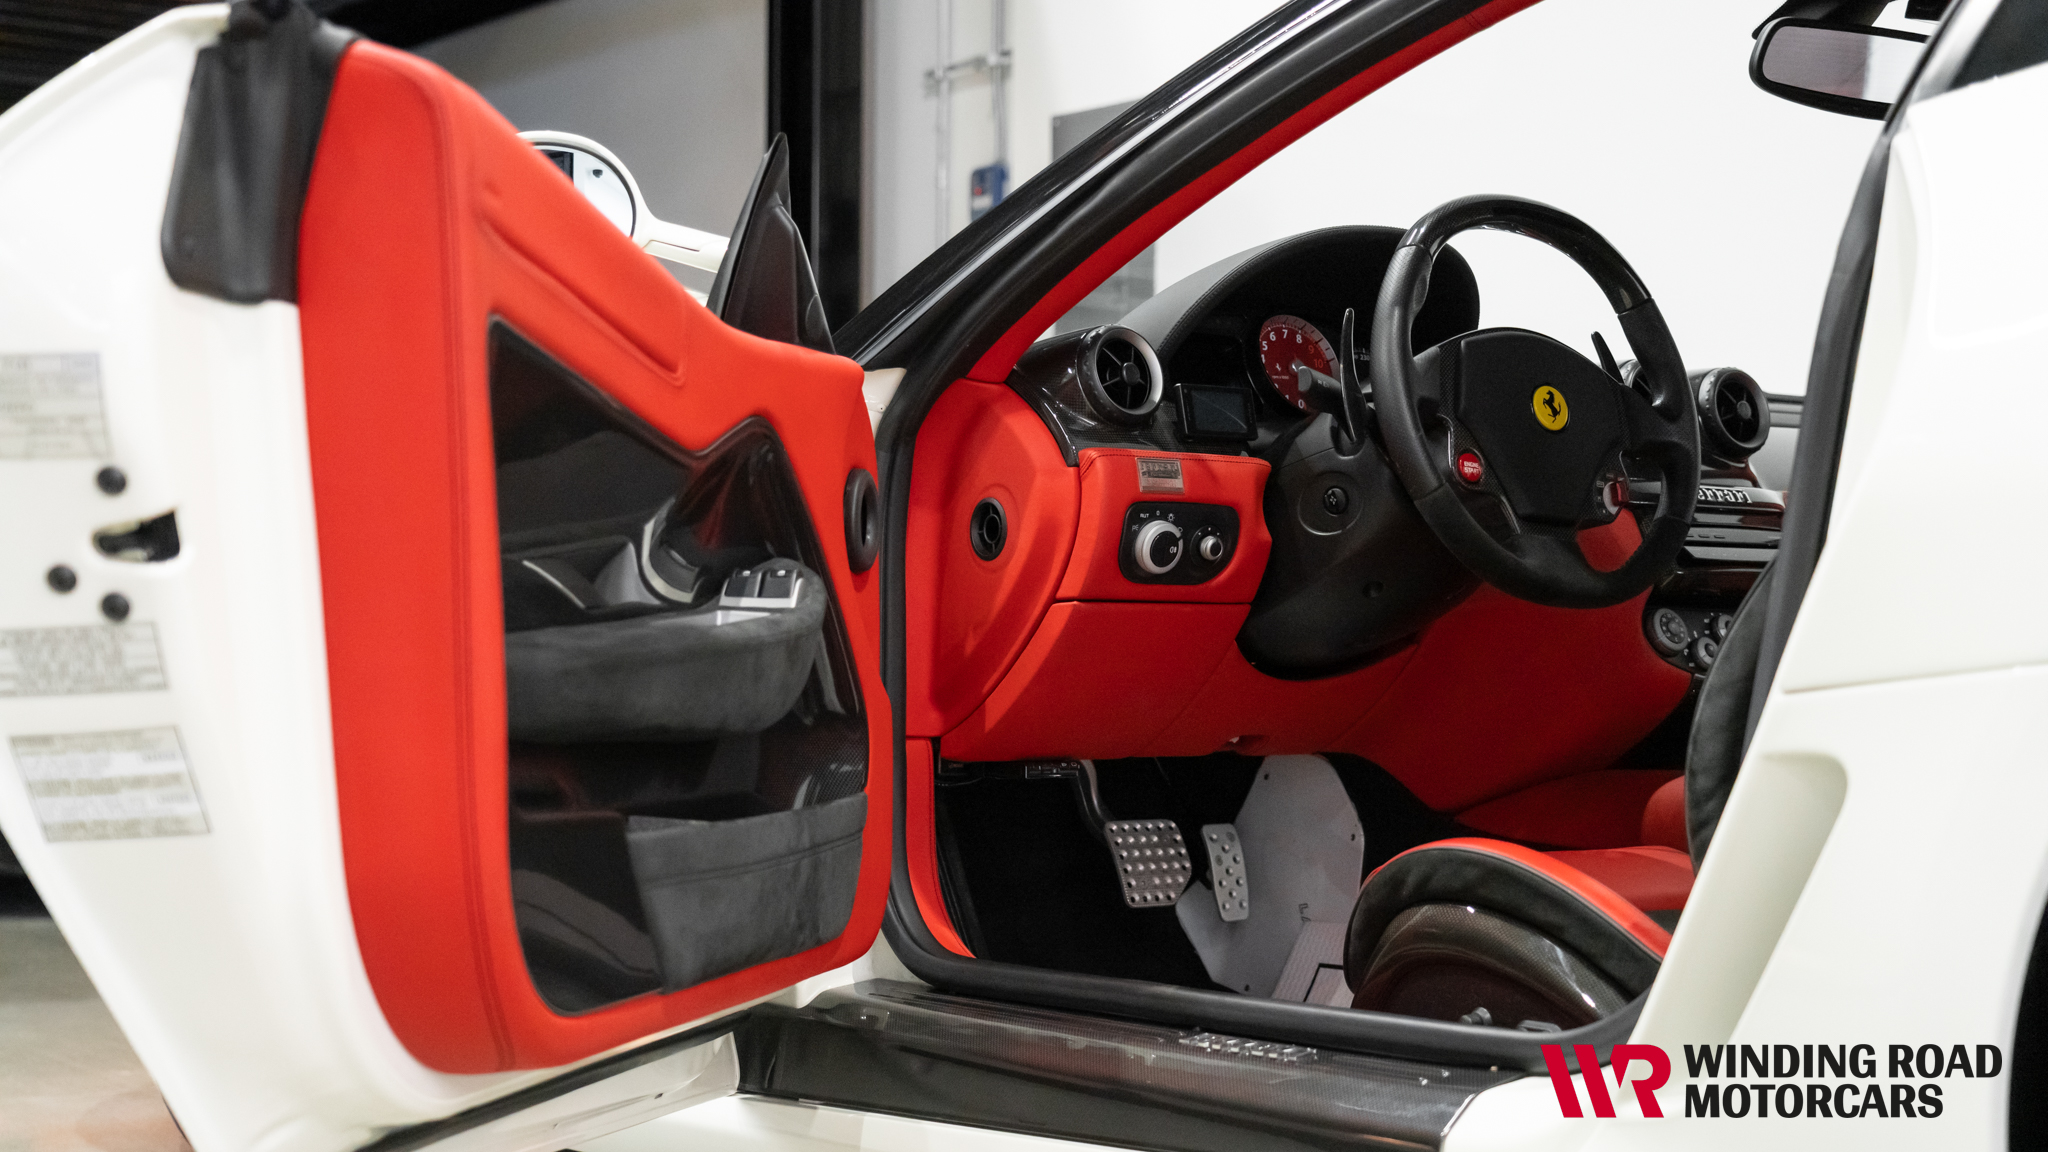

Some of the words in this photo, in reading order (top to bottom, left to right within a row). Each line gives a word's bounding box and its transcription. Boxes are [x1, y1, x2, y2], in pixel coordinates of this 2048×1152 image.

[1269, 332, 1276, 341] 6
[1282, 329, 1288, 338] 7
[1296, 334, 1302, 343] 8
[1262, 341, 1268, 350] 5
[1308, 345, 1315, 354] 9
[1314, 358, 1324, 368] 10
[1298, 400, 1304, 408] 0
[1698, 488, 1752, 503] errari
